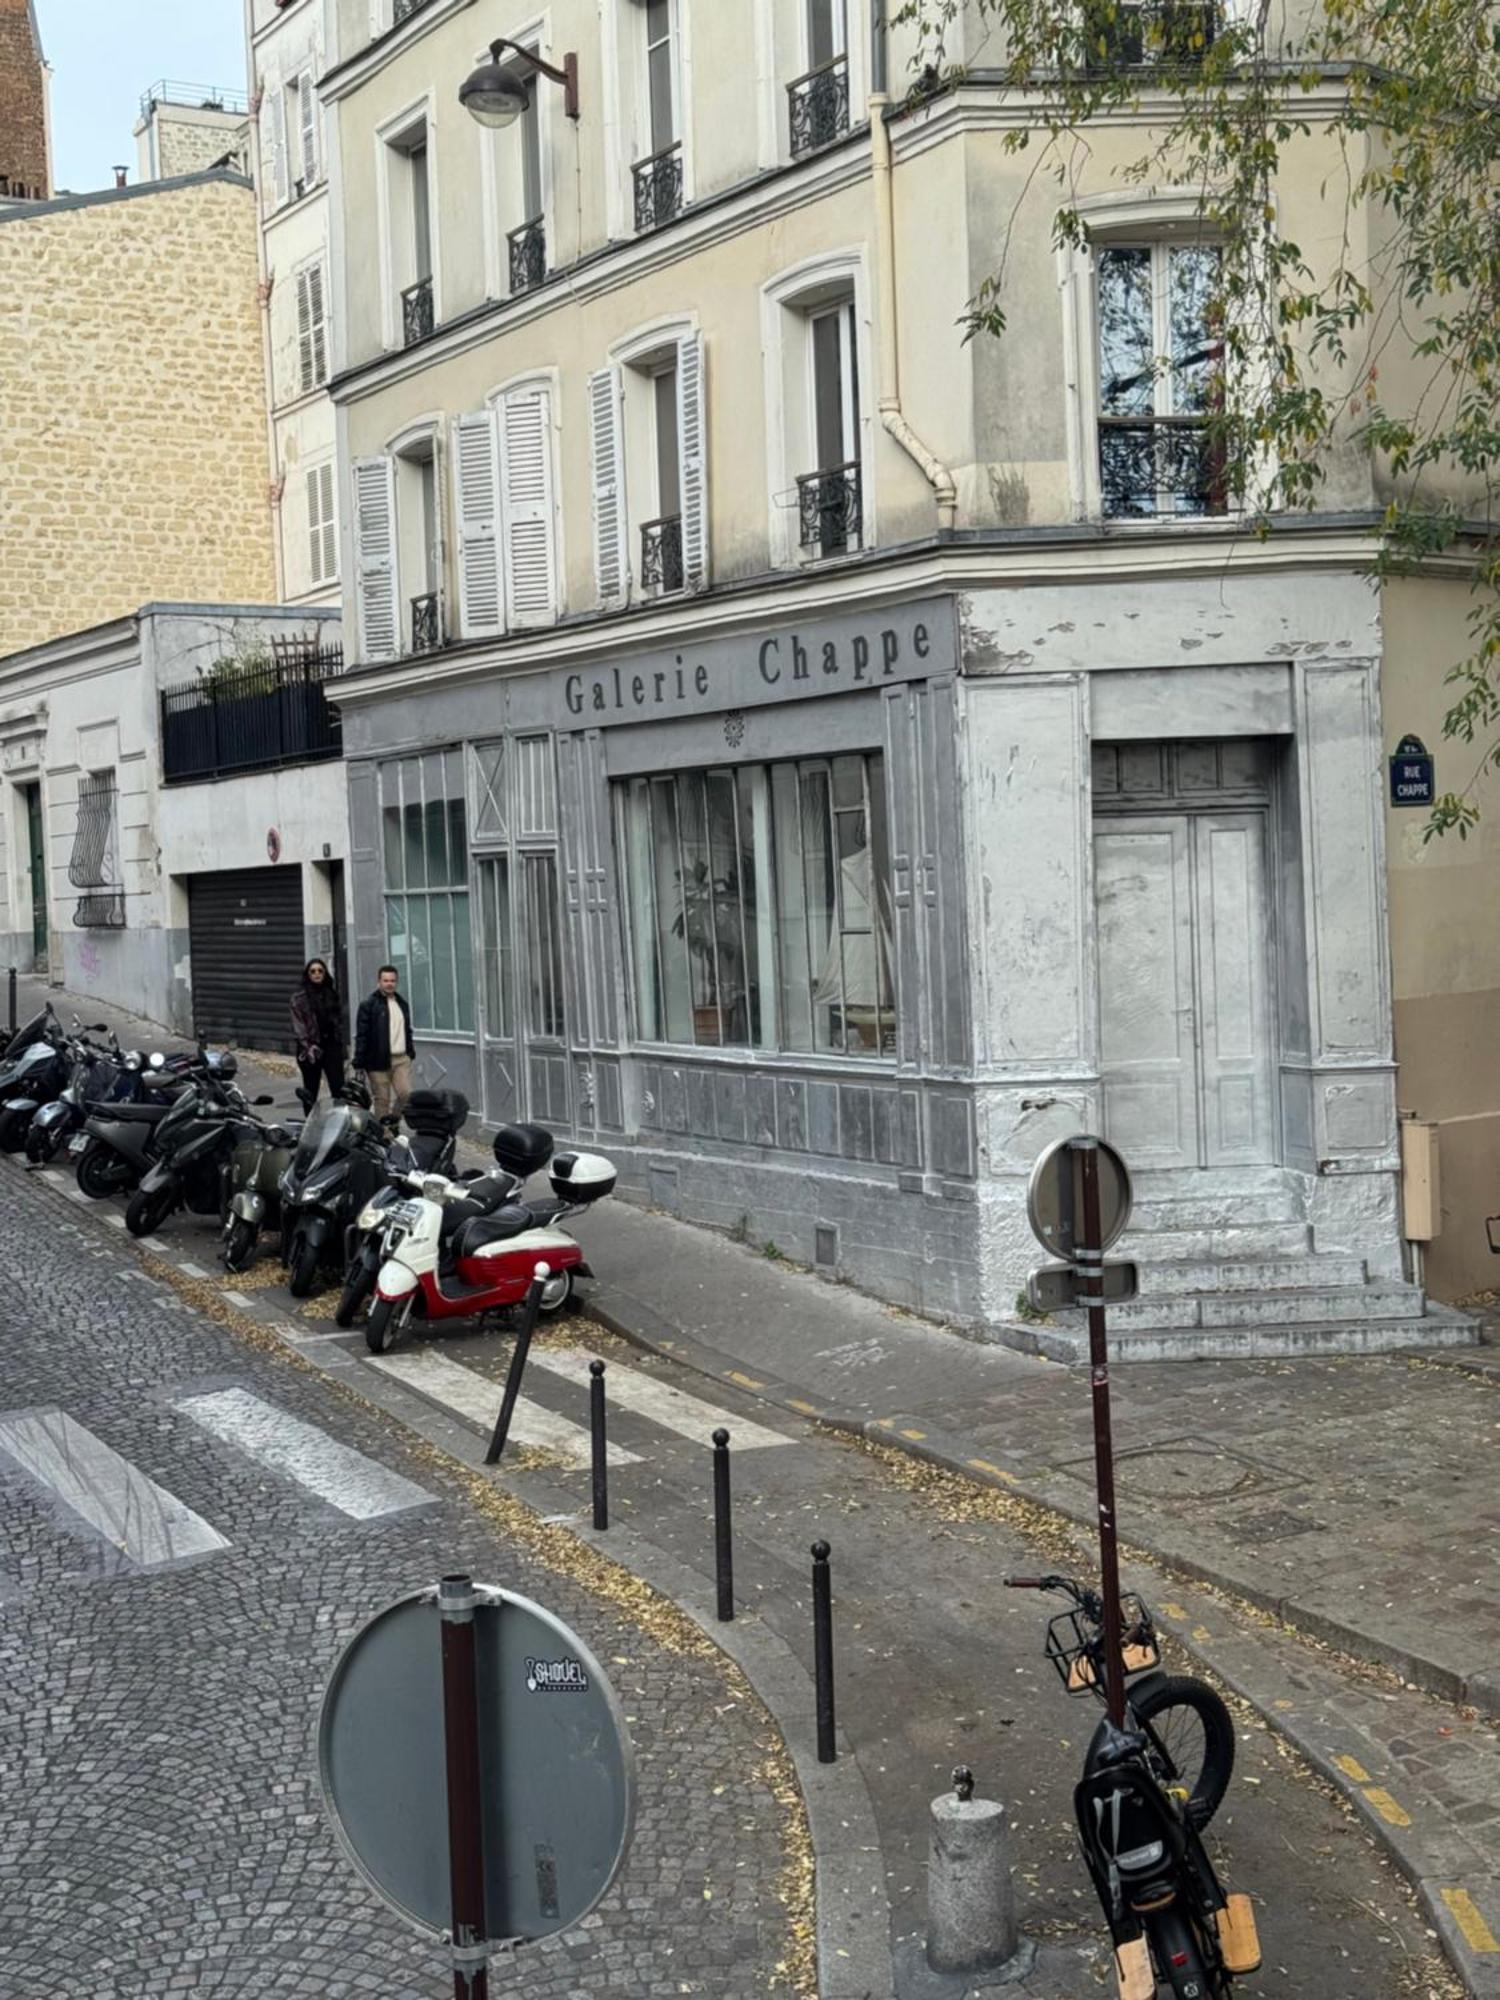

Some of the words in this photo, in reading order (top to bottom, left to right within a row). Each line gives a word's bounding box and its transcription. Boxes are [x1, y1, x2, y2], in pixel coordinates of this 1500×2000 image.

[566, 655, 709, 714] Galerie
[758, 622, 931, 685] Chappe
[1404, 766, 1420, 778] RUE
[1397, 783, 1429, 797] CHAPPE
